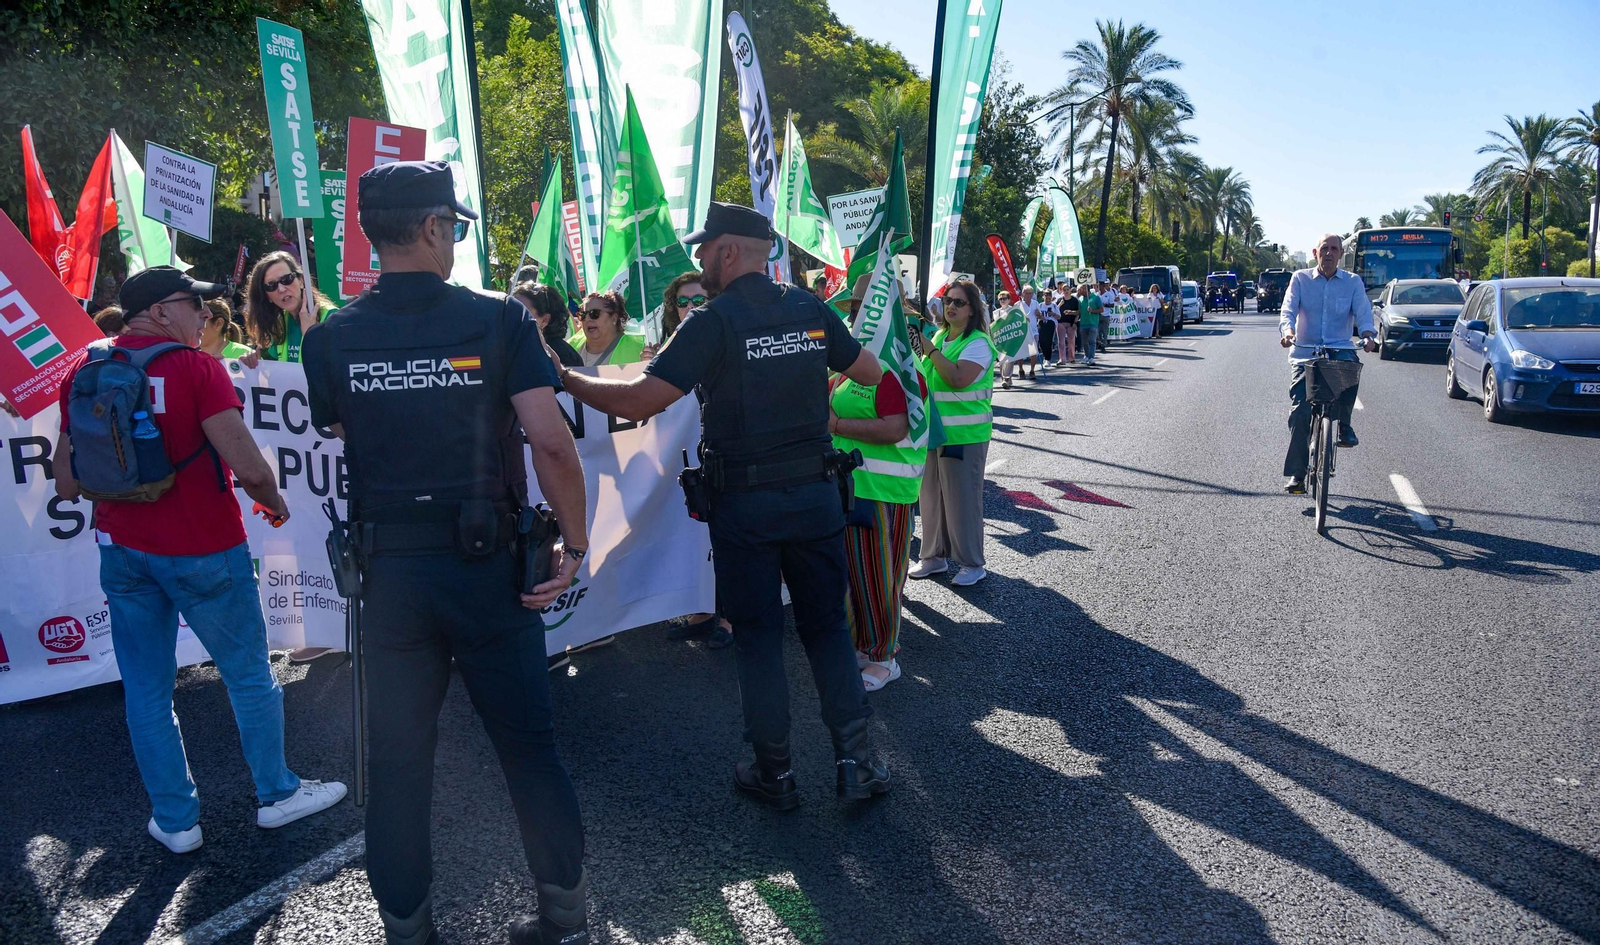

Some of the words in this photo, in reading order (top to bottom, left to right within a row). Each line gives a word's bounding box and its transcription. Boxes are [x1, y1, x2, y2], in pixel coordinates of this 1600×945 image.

[271, 33, 296, 50] SATSE
[266, 43, 302, 62] SEVILLA
[280, 62, 310, 207] SATSE
[162, 155, 187, 172] CONTRA
[187, 164, 196, 174] LA
[155, 166, 202, 191] PRIVATIZACIÓN
[150, 178, 159, 188] DE
[159, 183, 167, 191] LA
[167, 185, 195, 202] SANIDAD
[195, 195, 205, 206] EN
[159, 195, 194, 215] ANDALUCÍA
[832, 200, 848, 210] POR
[849, 197, 859, 206] LA
[843, 208, 874, 220] PÚBLICA
[747, 340, 826, 360] NACIONAL
[12, 365, 56, 395] FEDERACIÓN
[55, 359, 67, 369] DE
[350, 372, 483, 393] NACIONAL
[15, 378, 52, 403] SECTORES
[43, 385, 55, 395] DE
[850, 389, 871, 400] SEVILLA
[268, 570, 334, 590] Sindicato
[268, 592, 288, 609] de
[43, 619, 77, 639] UGT
[89, 624, 111, 634] Servicios
[269, 614, 303, 625] Sevilla
